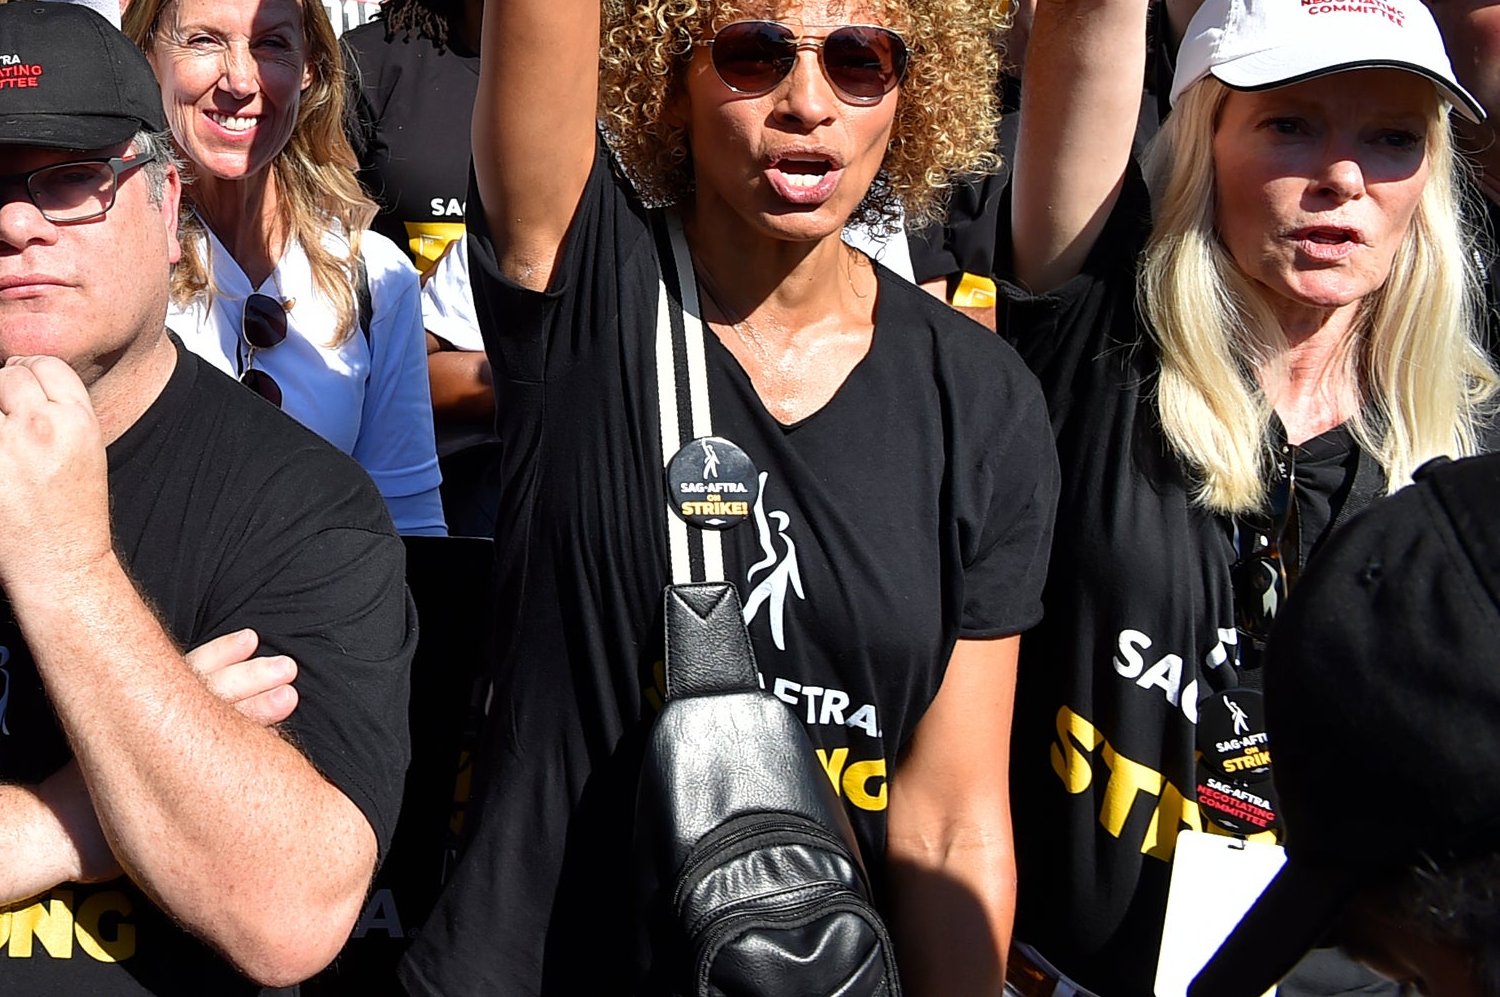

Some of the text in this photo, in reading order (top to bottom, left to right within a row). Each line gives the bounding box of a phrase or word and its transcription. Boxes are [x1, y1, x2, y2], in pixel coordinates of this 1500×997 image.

[1308, 5, 1404, 28] COMMITTEE
[681, 502, 748, 515] STRIKE!
[1244, 746, 1259, 754] ON
[1222, 752, 1272, 773] STRIK
[1197, 784, 1275, 821] NEGOTIATING
[1200, 796, 1268, 828] COMMITTEE
